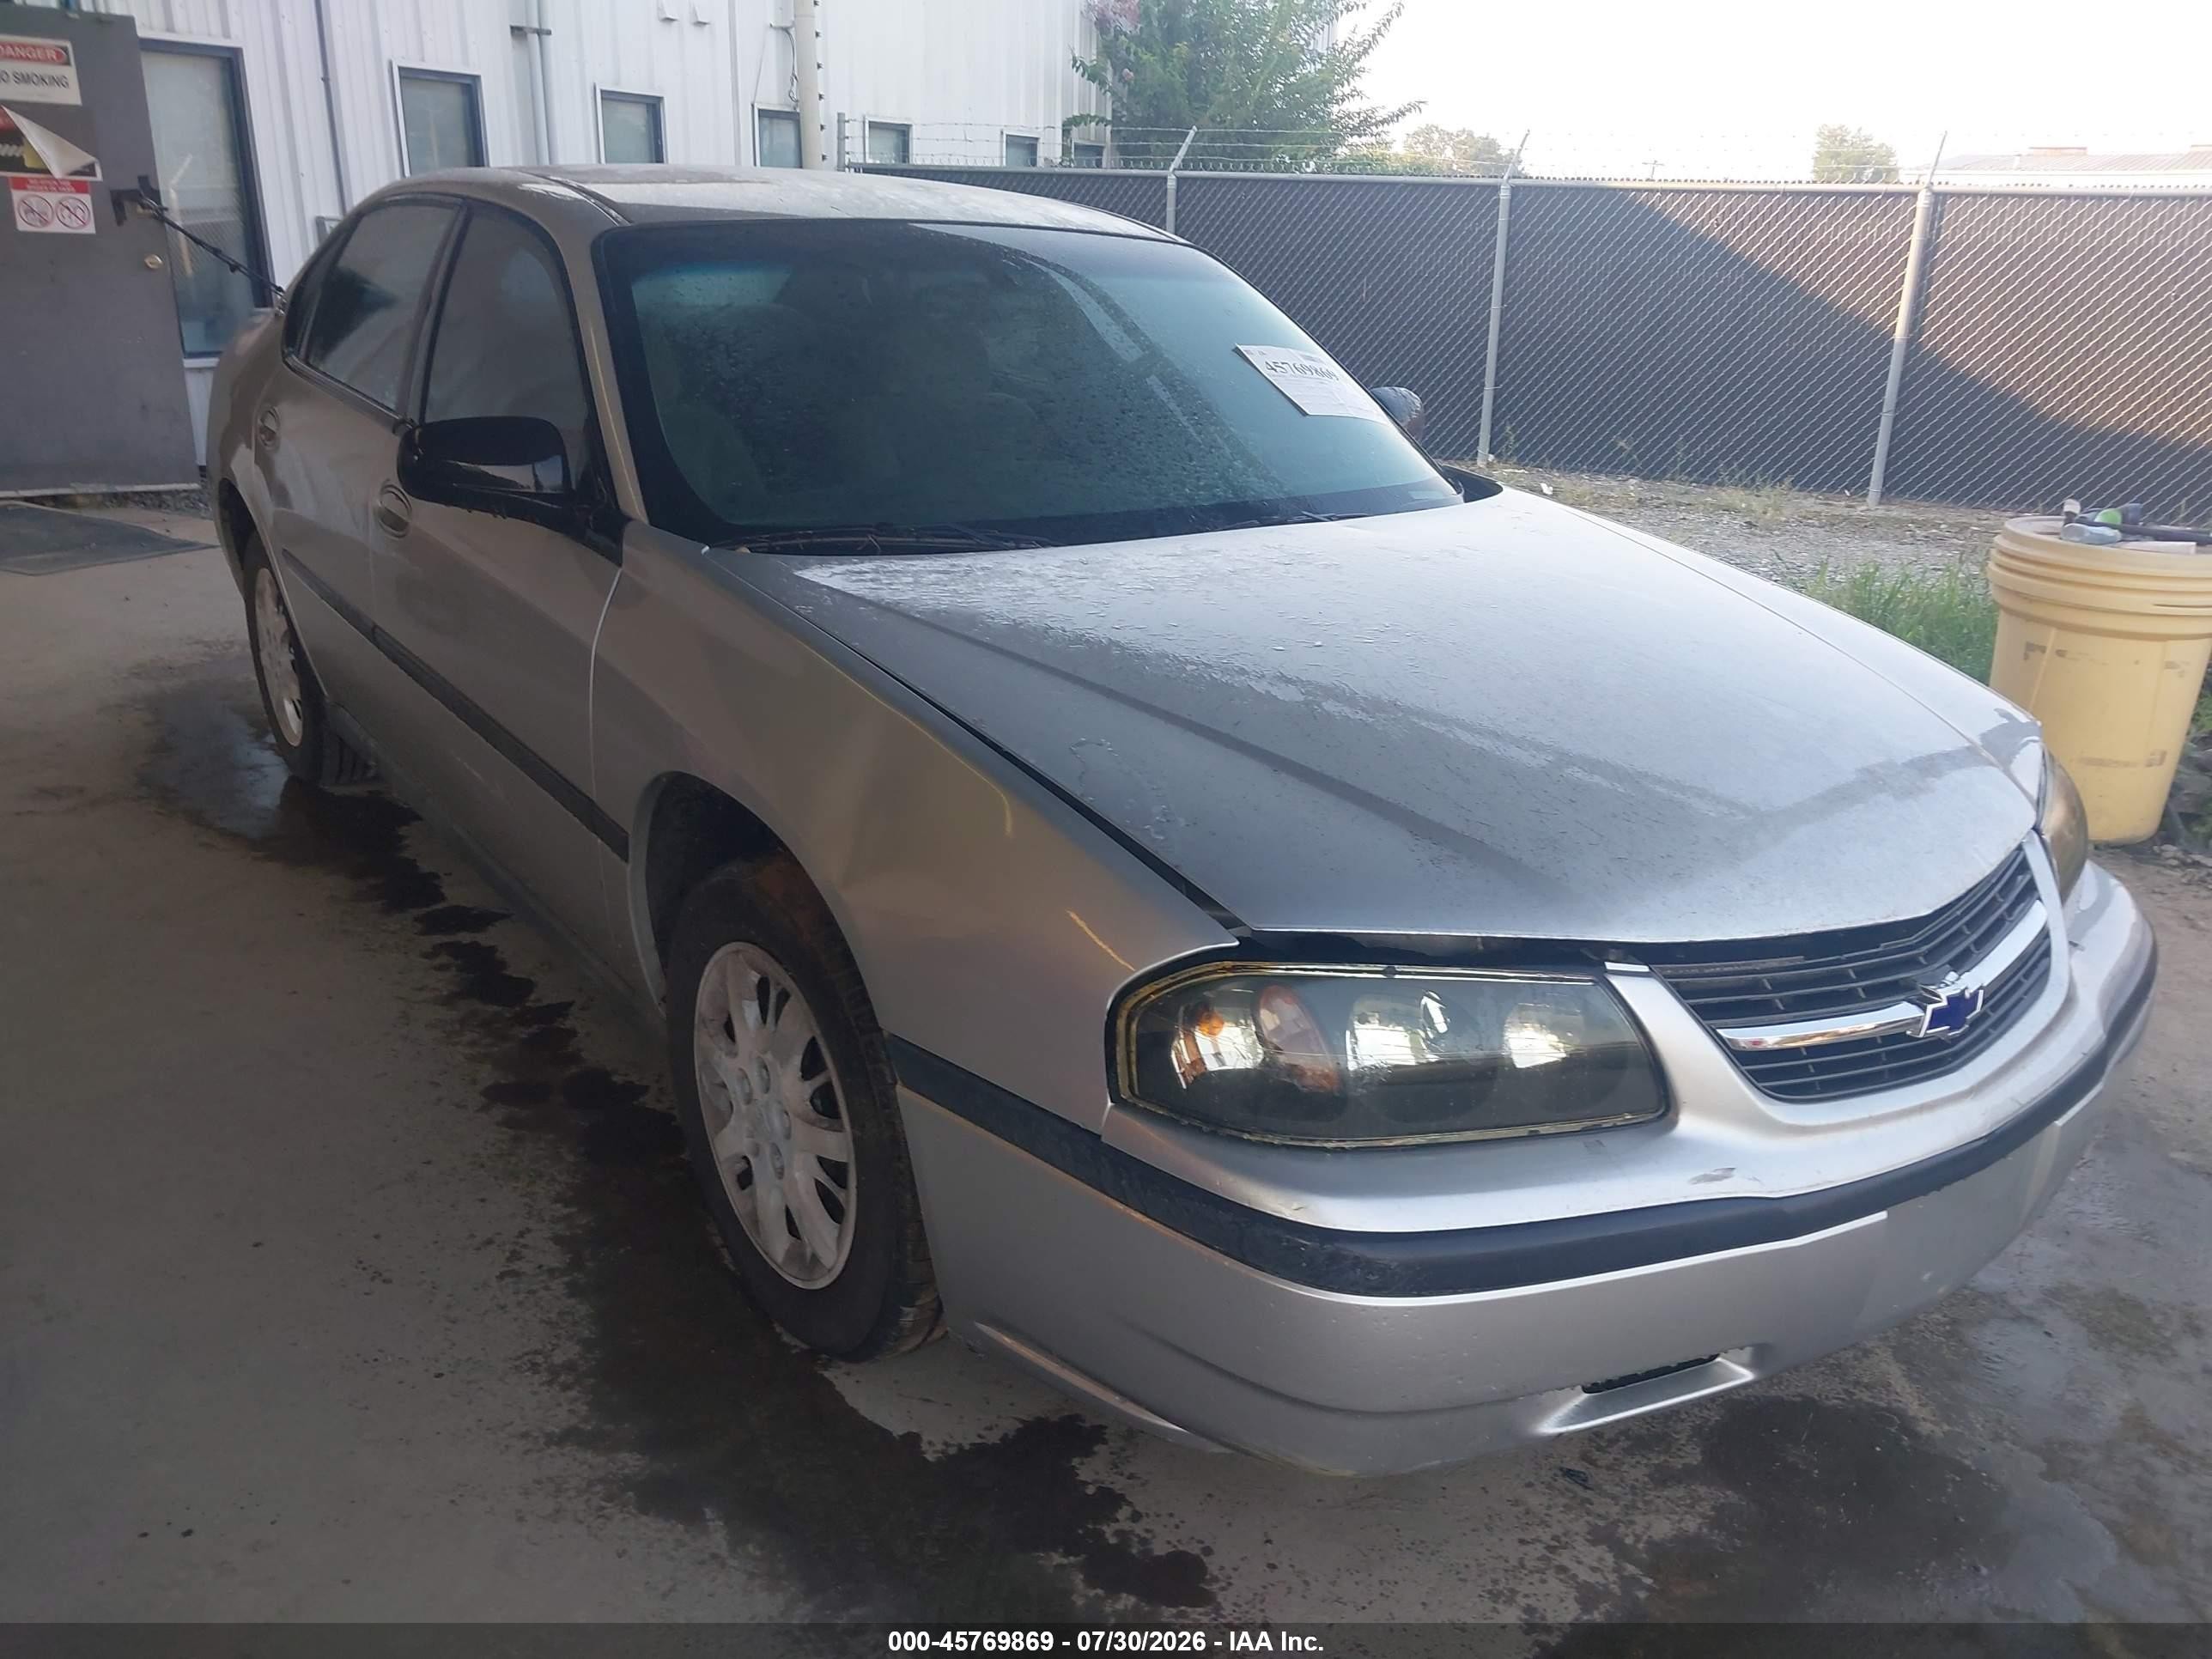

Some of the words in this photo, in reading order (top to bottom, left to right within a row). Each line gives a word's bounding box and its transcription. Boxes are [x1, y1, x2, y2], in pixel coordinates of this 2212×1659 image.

[0, 70, 9, 83] O
[12, 70, 70, 89] SMOKING
[1265, 361, 1339, 381] 45769869
